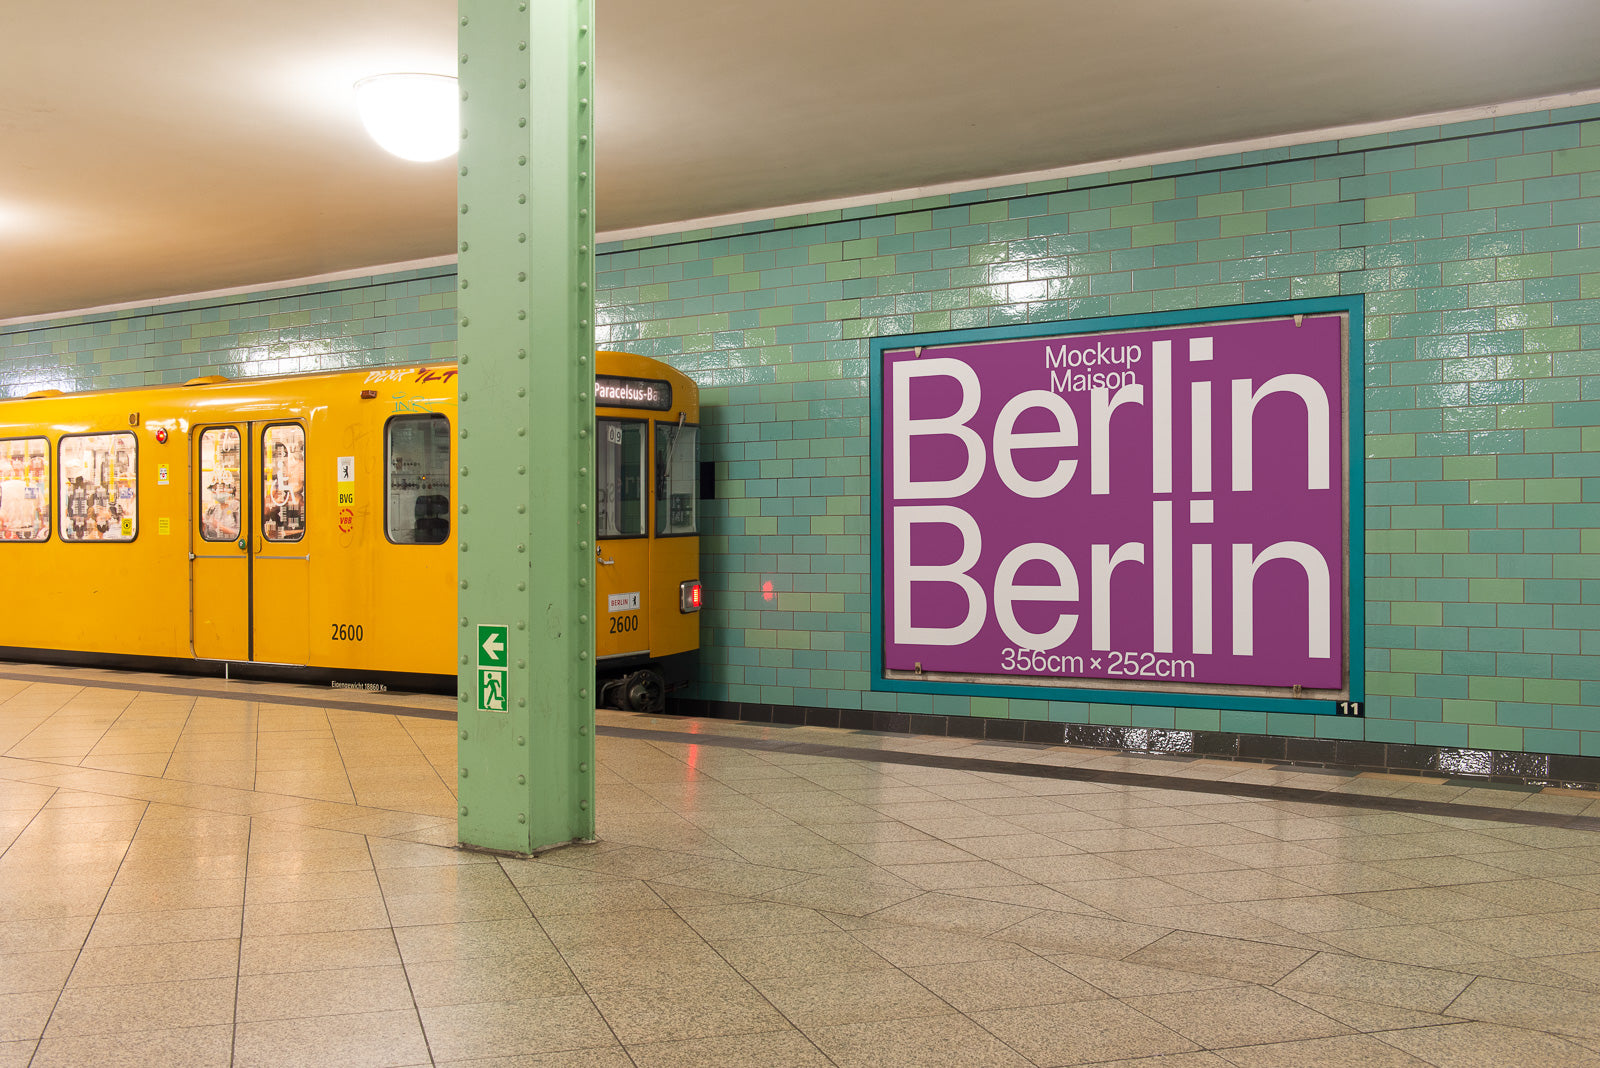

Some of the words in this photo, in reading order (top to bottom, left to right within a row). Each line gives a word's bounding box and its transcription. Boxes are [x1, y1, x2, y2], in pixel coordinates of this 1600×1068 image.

[1045, 341, 1142, 369] Mockup
[1050, 367, 1136, 393] Maison
[892, 336, 1331, 500] Berlin
[339, 493, 353, 504] BVG
[339, 516, 353, 525] VBB
[892, 499, 1331, 660] Berlin
[610, 598, 628, 607] BERLIN
[331, 623, 363, 641] 2600
[609, 614, 638, 634] 2600
[1001, 647, 1084, 673] 356cm
[1107, 651, 1195, 678] 252cm
[1340, 701, 1359, 715] 11
